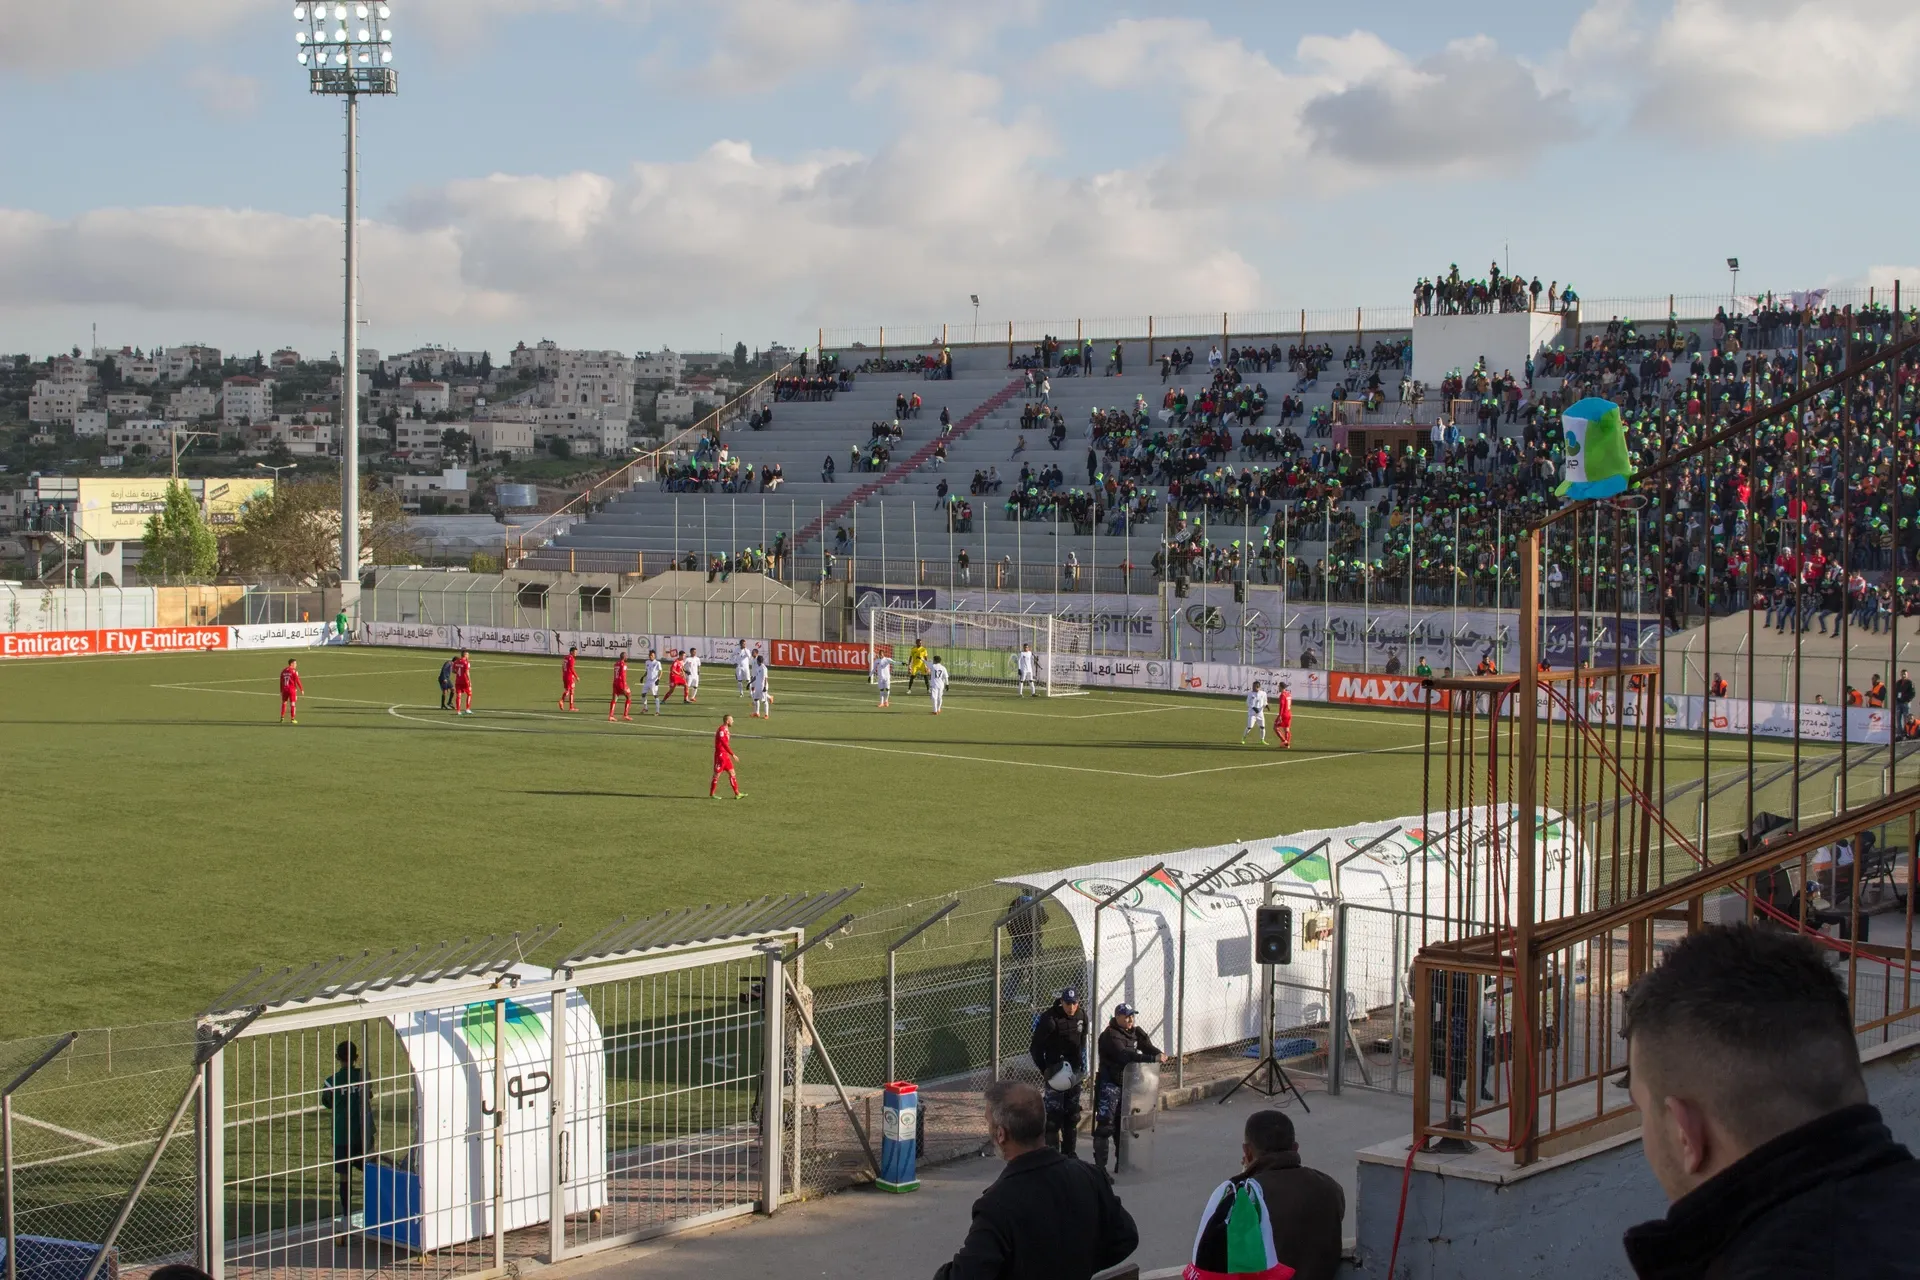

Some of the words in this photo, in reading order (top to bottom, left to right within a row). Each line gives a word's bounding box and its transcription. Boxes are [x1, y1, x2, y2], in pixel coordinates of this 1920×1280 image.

[3, 634, 89, 654] Emirates
[106, 631, 137, 652] Fly
[141, 629, 221, 648] Emirates
[777, 643, 806, 666] Fly
[809, 645, 876, 665] Emirate
